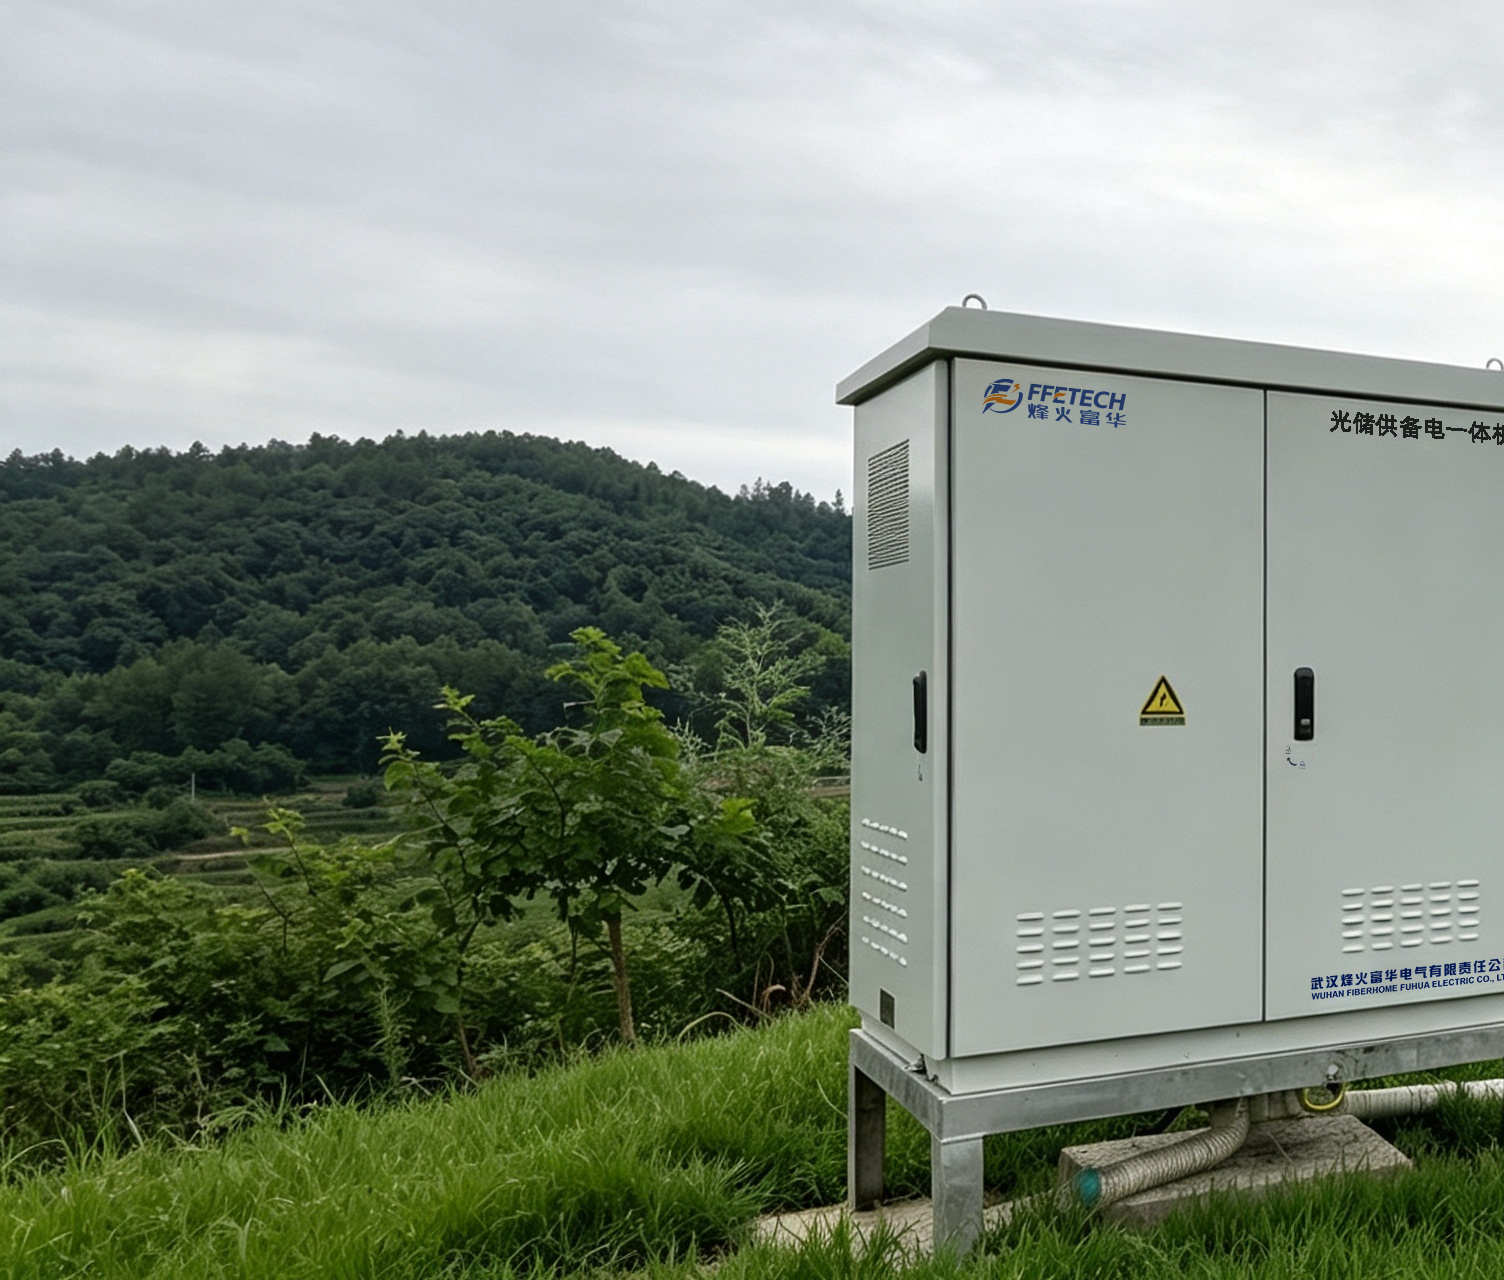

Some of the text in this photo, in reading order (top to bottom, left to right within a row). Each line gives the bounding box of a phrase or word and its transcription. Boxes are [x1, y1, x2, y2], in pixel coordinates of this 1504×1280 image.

[1027, 383, 1127, 411] FFETECH
[1027, 402, 1127, 428] 烽火富华
[1311, 989, 1345, 1000] WUHAN
[1346, 984, 1398, 997] FIBERHOME
[1400, 981, 1431, 992] FUHUA
[1432, 976, 1475, 988] ELECTRIC
[1476, 974, 1495, 984] CO.,
